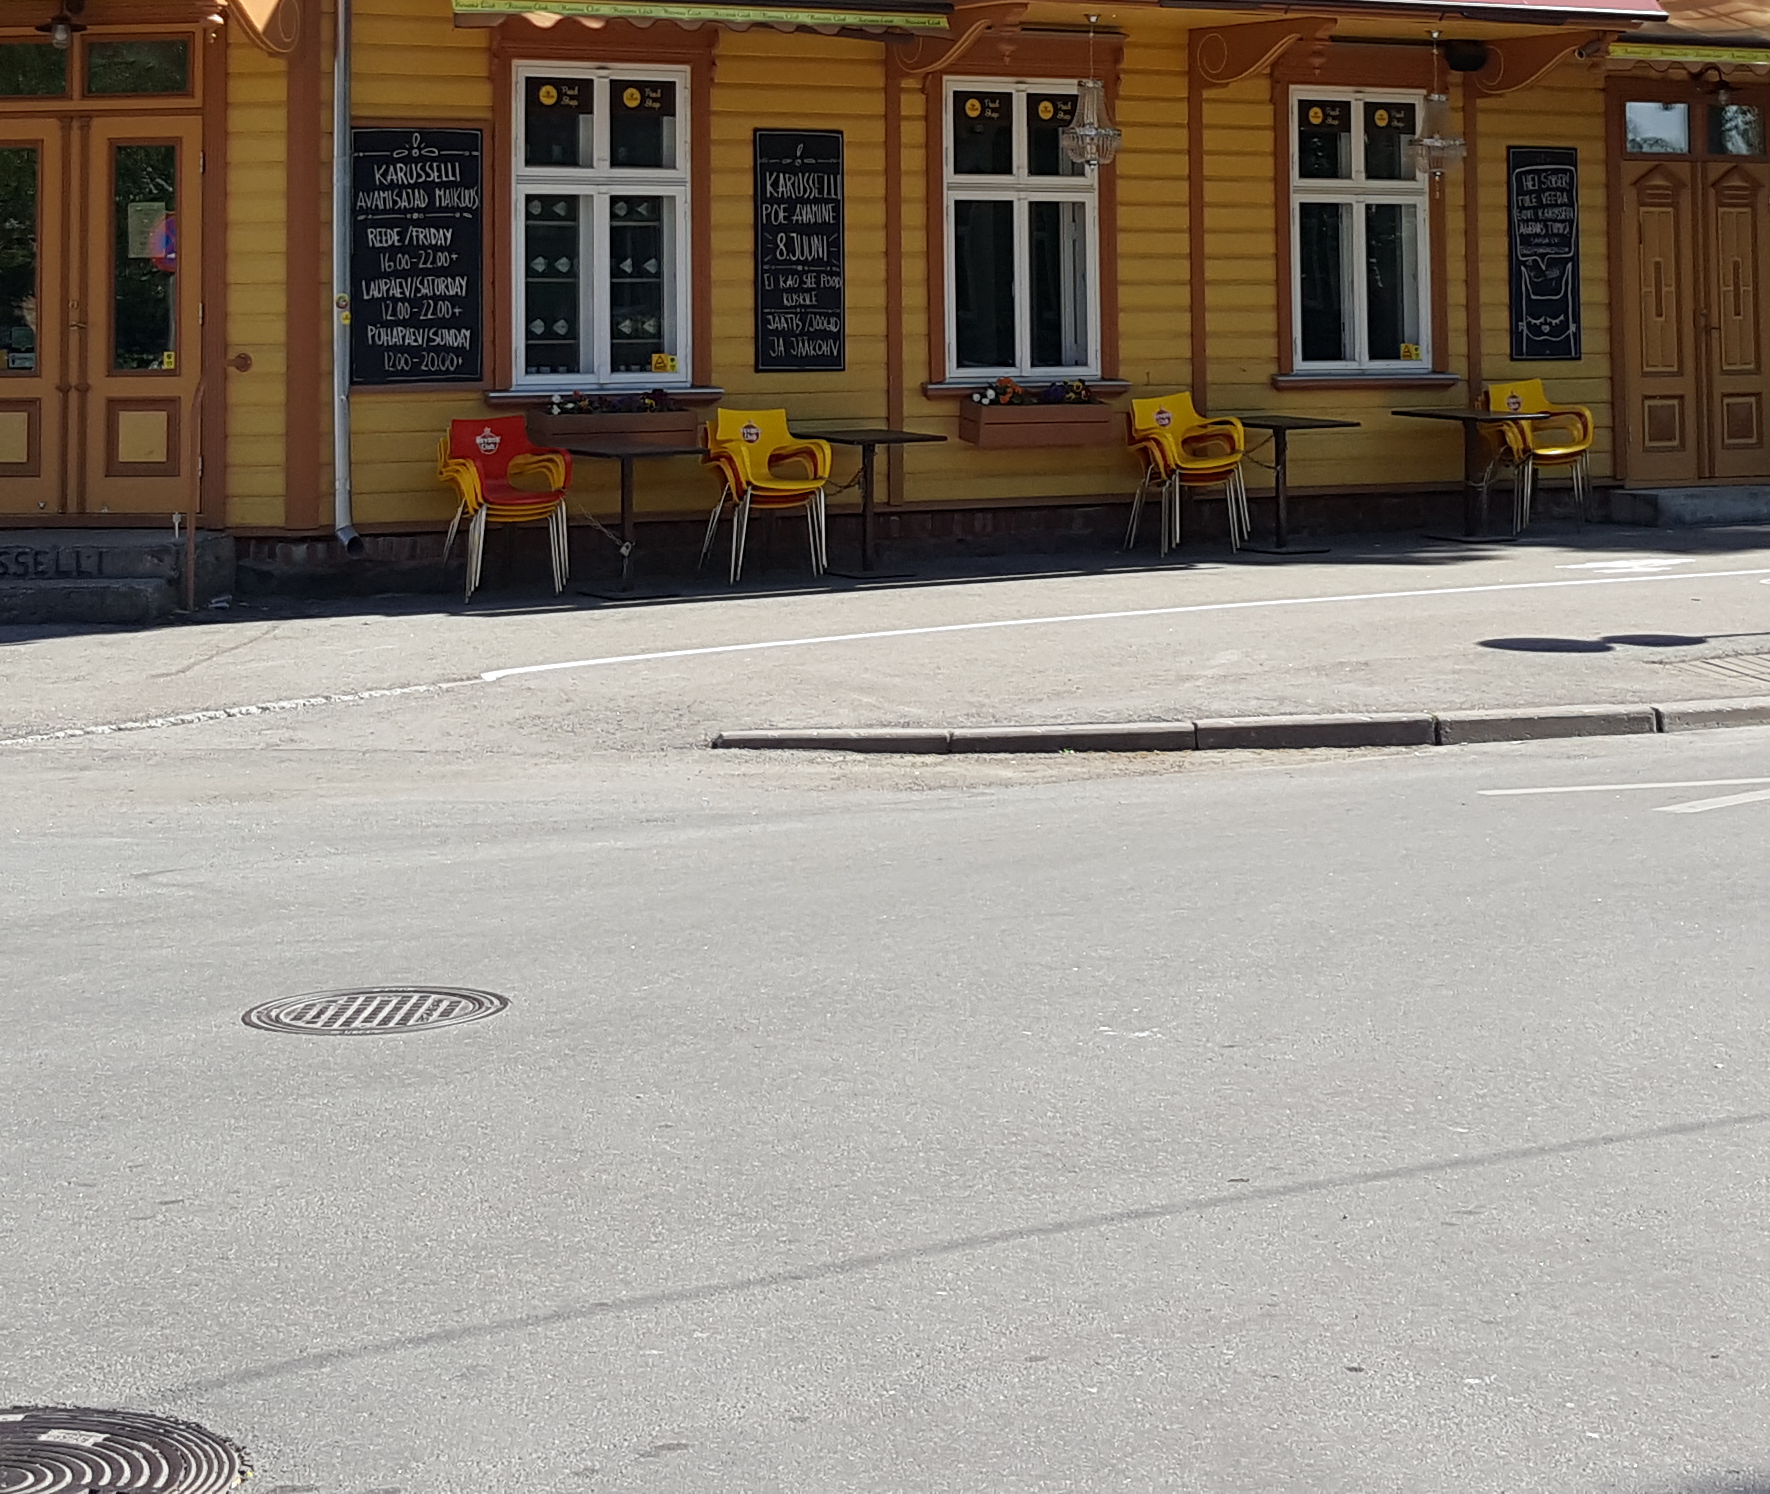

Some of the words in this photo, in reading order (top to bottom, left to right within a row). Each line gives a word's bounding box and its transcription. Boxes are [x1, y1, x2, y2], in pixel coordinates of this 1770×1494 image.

[374, 162, 460, 185] KARUSSELLI
[1522, 174, 1538, 190] HEI
[766, 171, 841, 200] KARUSSELLI
[356, 188, 429, 210] AVAMISAJAD
[763, 204, 788, 225] POE
[792, 203, 836, 224] AVAMINE
[367, 227, 401, 247] REEDE
[764, 274, 774, 290] EI
[779, 274, 799, 288] KAO
[803, 273, 817, 288] SEE
[769, 337, 785, 357] JA
